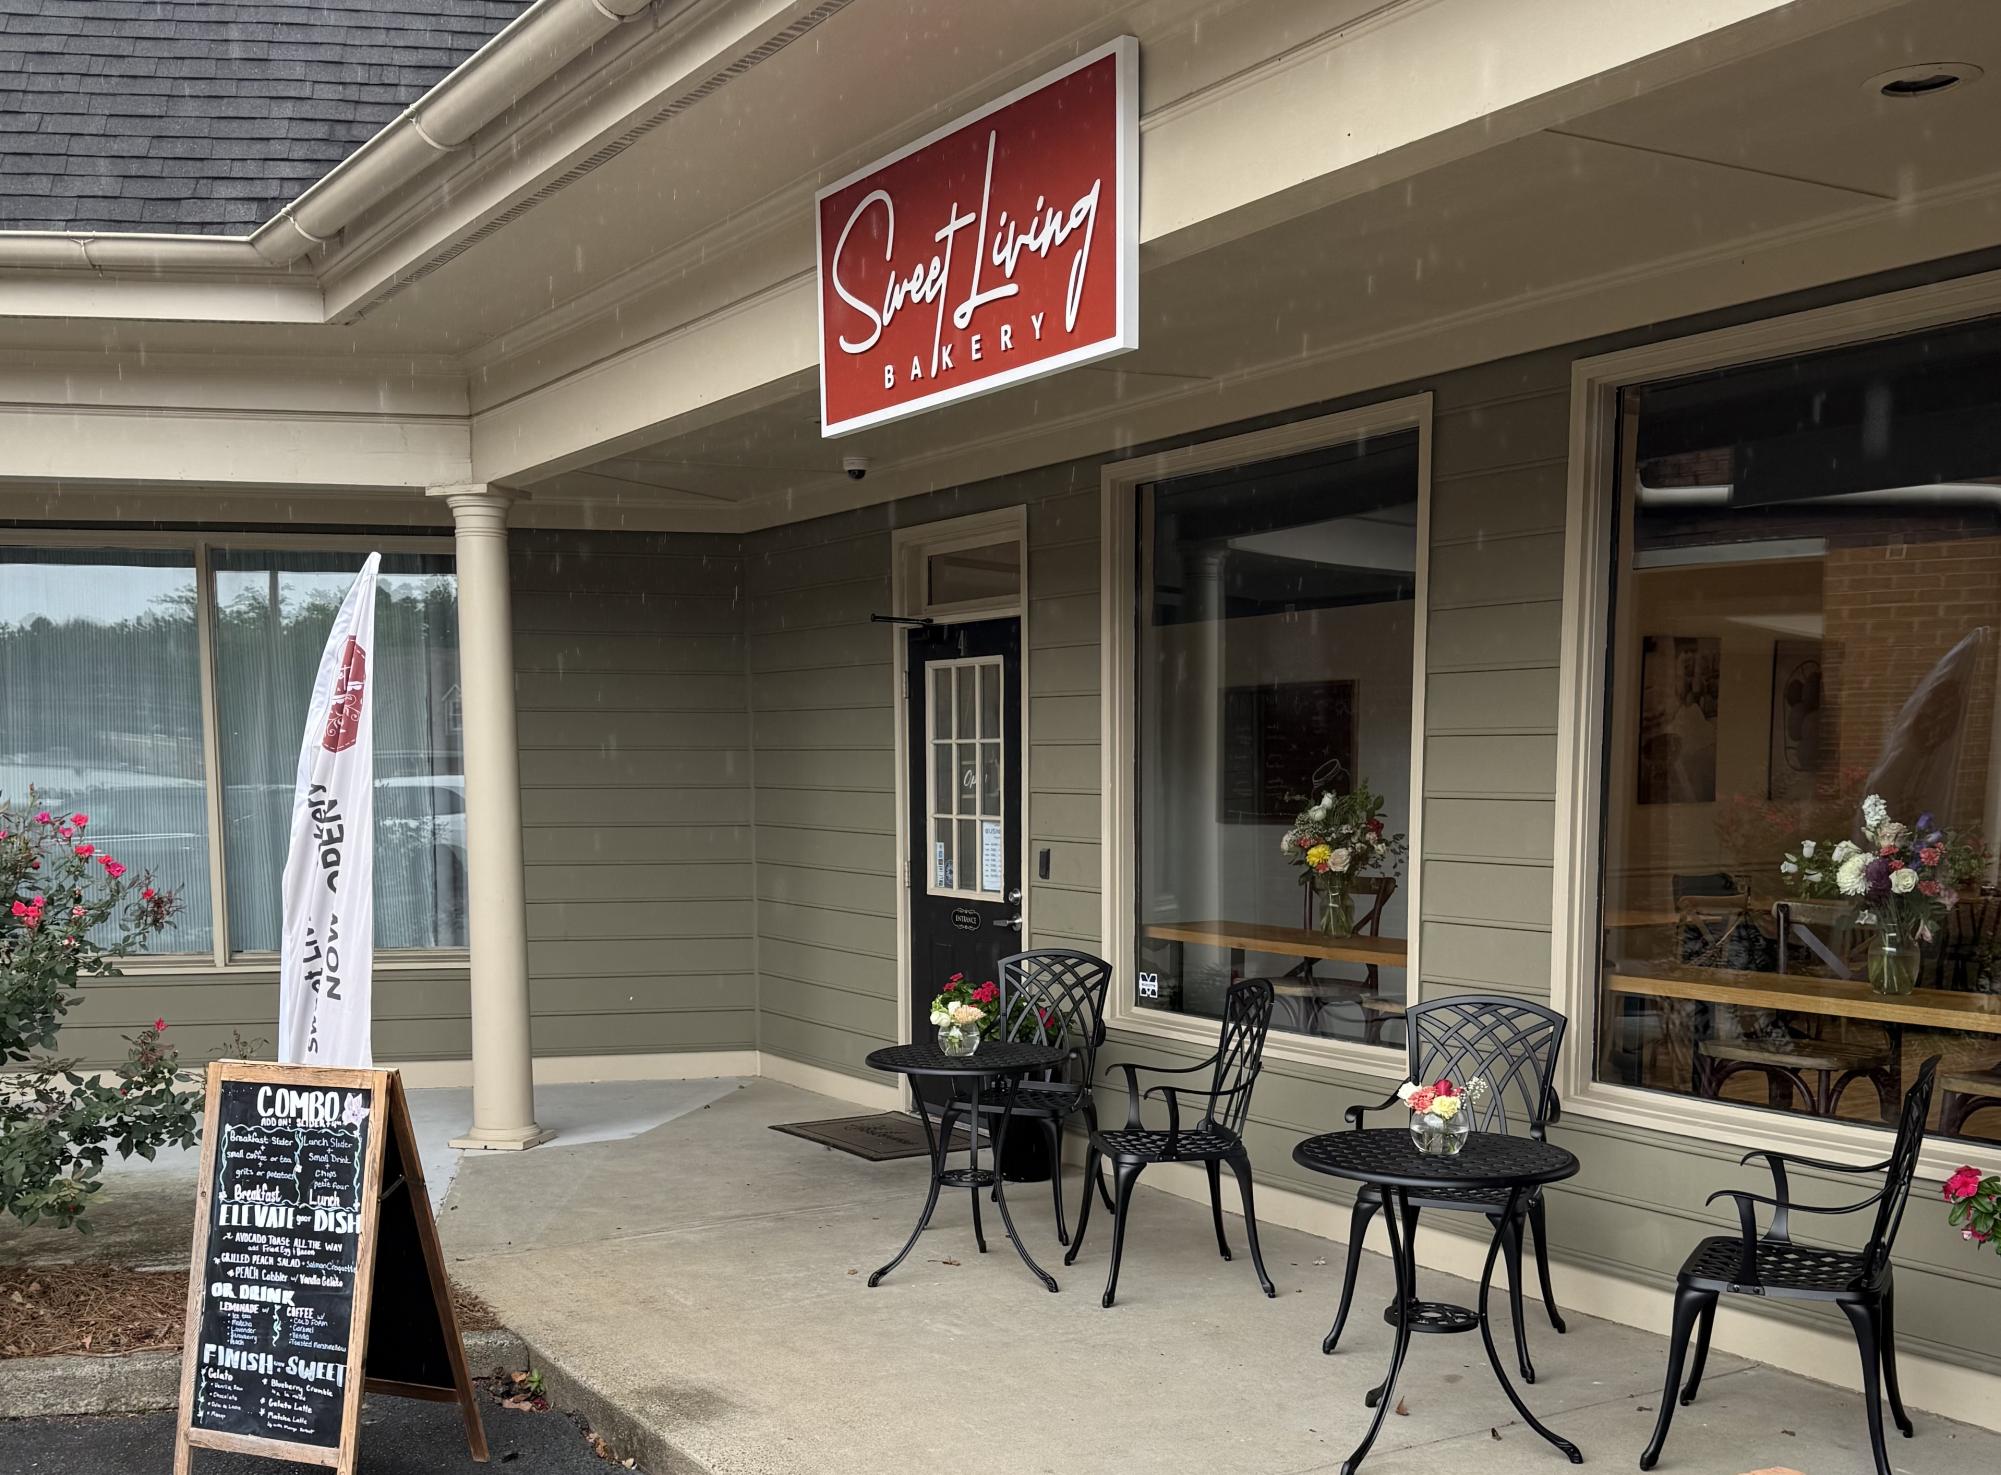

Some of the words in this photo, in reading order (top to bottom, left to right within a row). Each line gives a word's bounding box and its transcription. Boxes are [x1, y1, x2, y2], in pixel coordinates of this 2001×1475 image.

[832, 189, 976, 378] Sweet
[953, 130, 1101, 333] Living
[884, 311, 1045, 389] BAKERY
[955, 914, 977, 925] ENTRANCE
[257, 1086, 340, 1121] COMBO
[229, 1131, 269, 1145] Breakfast
[271, 1136, 294, 1146] Slider
[303, 1135, 329, 1147] Lunch
[330, 1137, 353, 1149] Slider
[226, 1149, 244, 1159] small
[279, 1155, 292, 1164] tea
[308, 1152, 329, 1163] Small
[330, 1154, 352, 1164] Drink
[235, 1167, 254, 1179] grits
[234, 1183, 282, 1202] Breakfast
[309, 1188, 340, 1207] Lunch
[218, 1204, 295, 1229] ELEVATE
[313, 1209, 361, 1234] DISH
[235, 1232, 267, 1244] AVOCADO
[293, 1237, 308, 1248] ALL
[324, 1243, 343, 1252] WAY
[221, 1252, 250, 1263] GRILLED
[252, 1254, 274, 1266] PEACH
[277, 1258, 301, 1268] SALAD
[235, 1266, 259, 1280] PEACH
[211, 1282, 238, 1299] OR
[239, 1285, 295, 1307] DRINK
[219, 1301, 260, 1314] LEMONADE
[286, 1306, 315, 1319] COFFEE
[203, 1343, 274, 1375] FINISH
[285, 1355, 348, 1388] SWEET
[207, 1367, 234, 1382] Gelato
[270, 1378, 304, 1396] Blueberry
[305, 1384, 334, 1398] Crumble
[268, 1398, 292, 1410] Gelato
[293, 1402, 313, 1414] Latte
